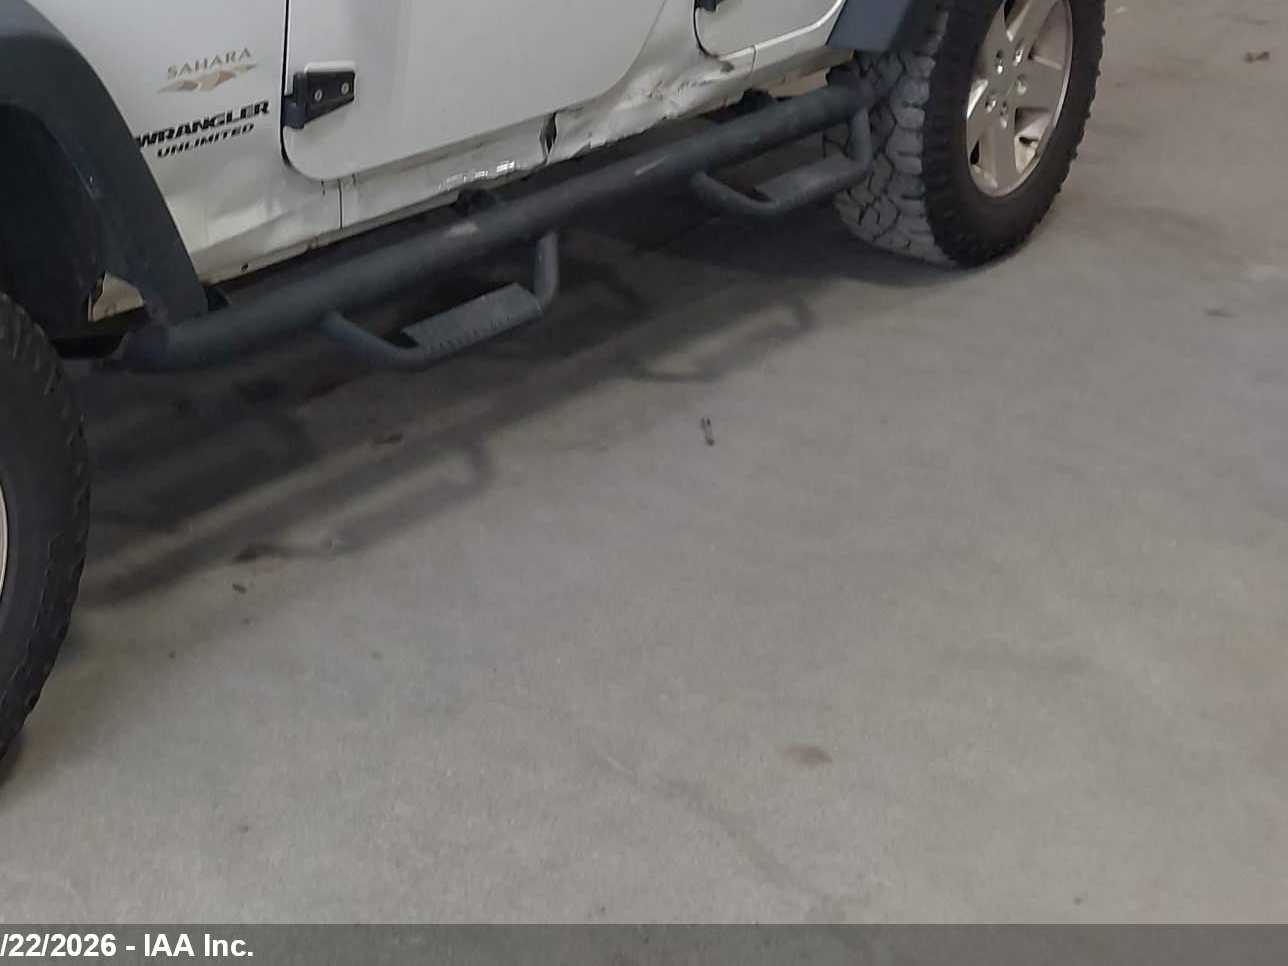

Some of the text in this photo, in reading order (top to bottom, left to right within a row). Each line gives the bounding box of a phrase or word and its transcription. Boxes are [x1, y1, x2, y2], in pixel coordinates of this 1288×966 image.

[167, 46, 251, 80] SAHARA
[136, 100, 269, 148] WRANGLER
[156, 122, 254, 158] UNLIMITED
